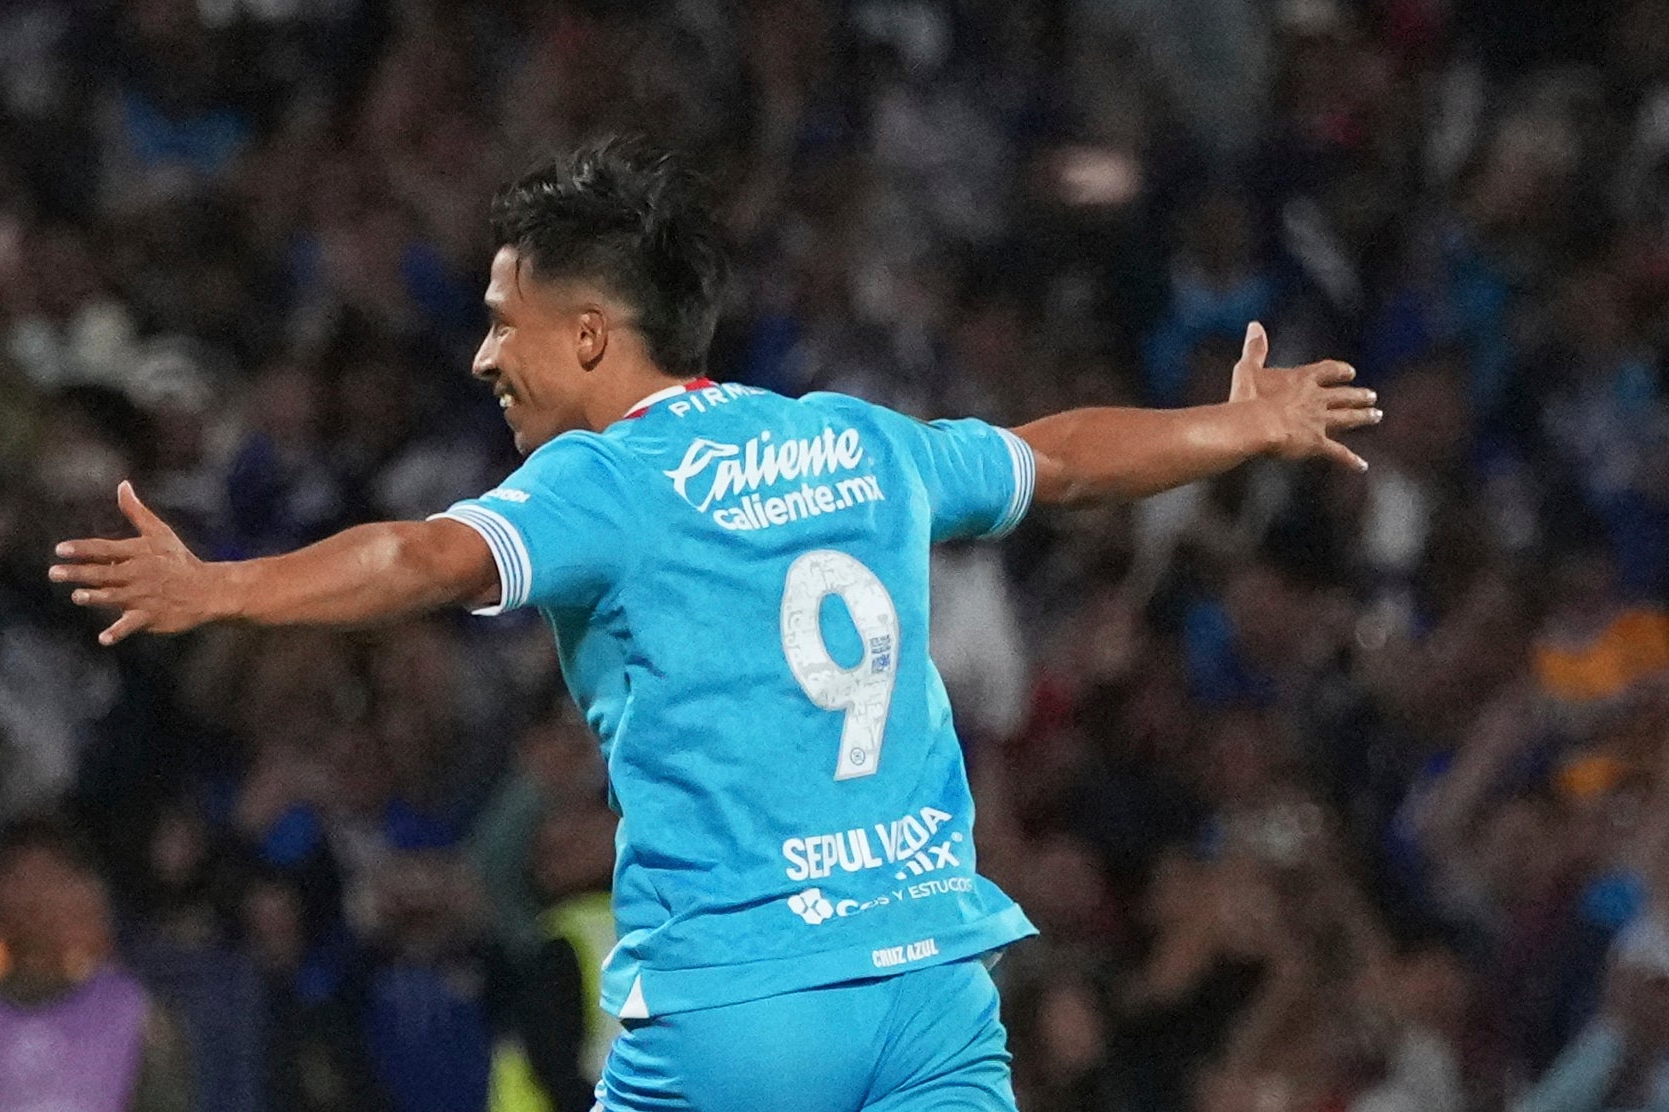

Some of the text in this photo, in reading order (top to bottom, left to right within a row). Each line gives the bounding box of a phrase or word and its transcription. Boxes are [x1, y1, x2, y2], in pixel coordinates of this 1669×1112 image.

[663, 428, 864, 513] Caliente
[713, 474, 886, 531] caliente.mx
[780, 548, 900, 782] 9
[872, 938, 939, 968] CRUZ AZUL
